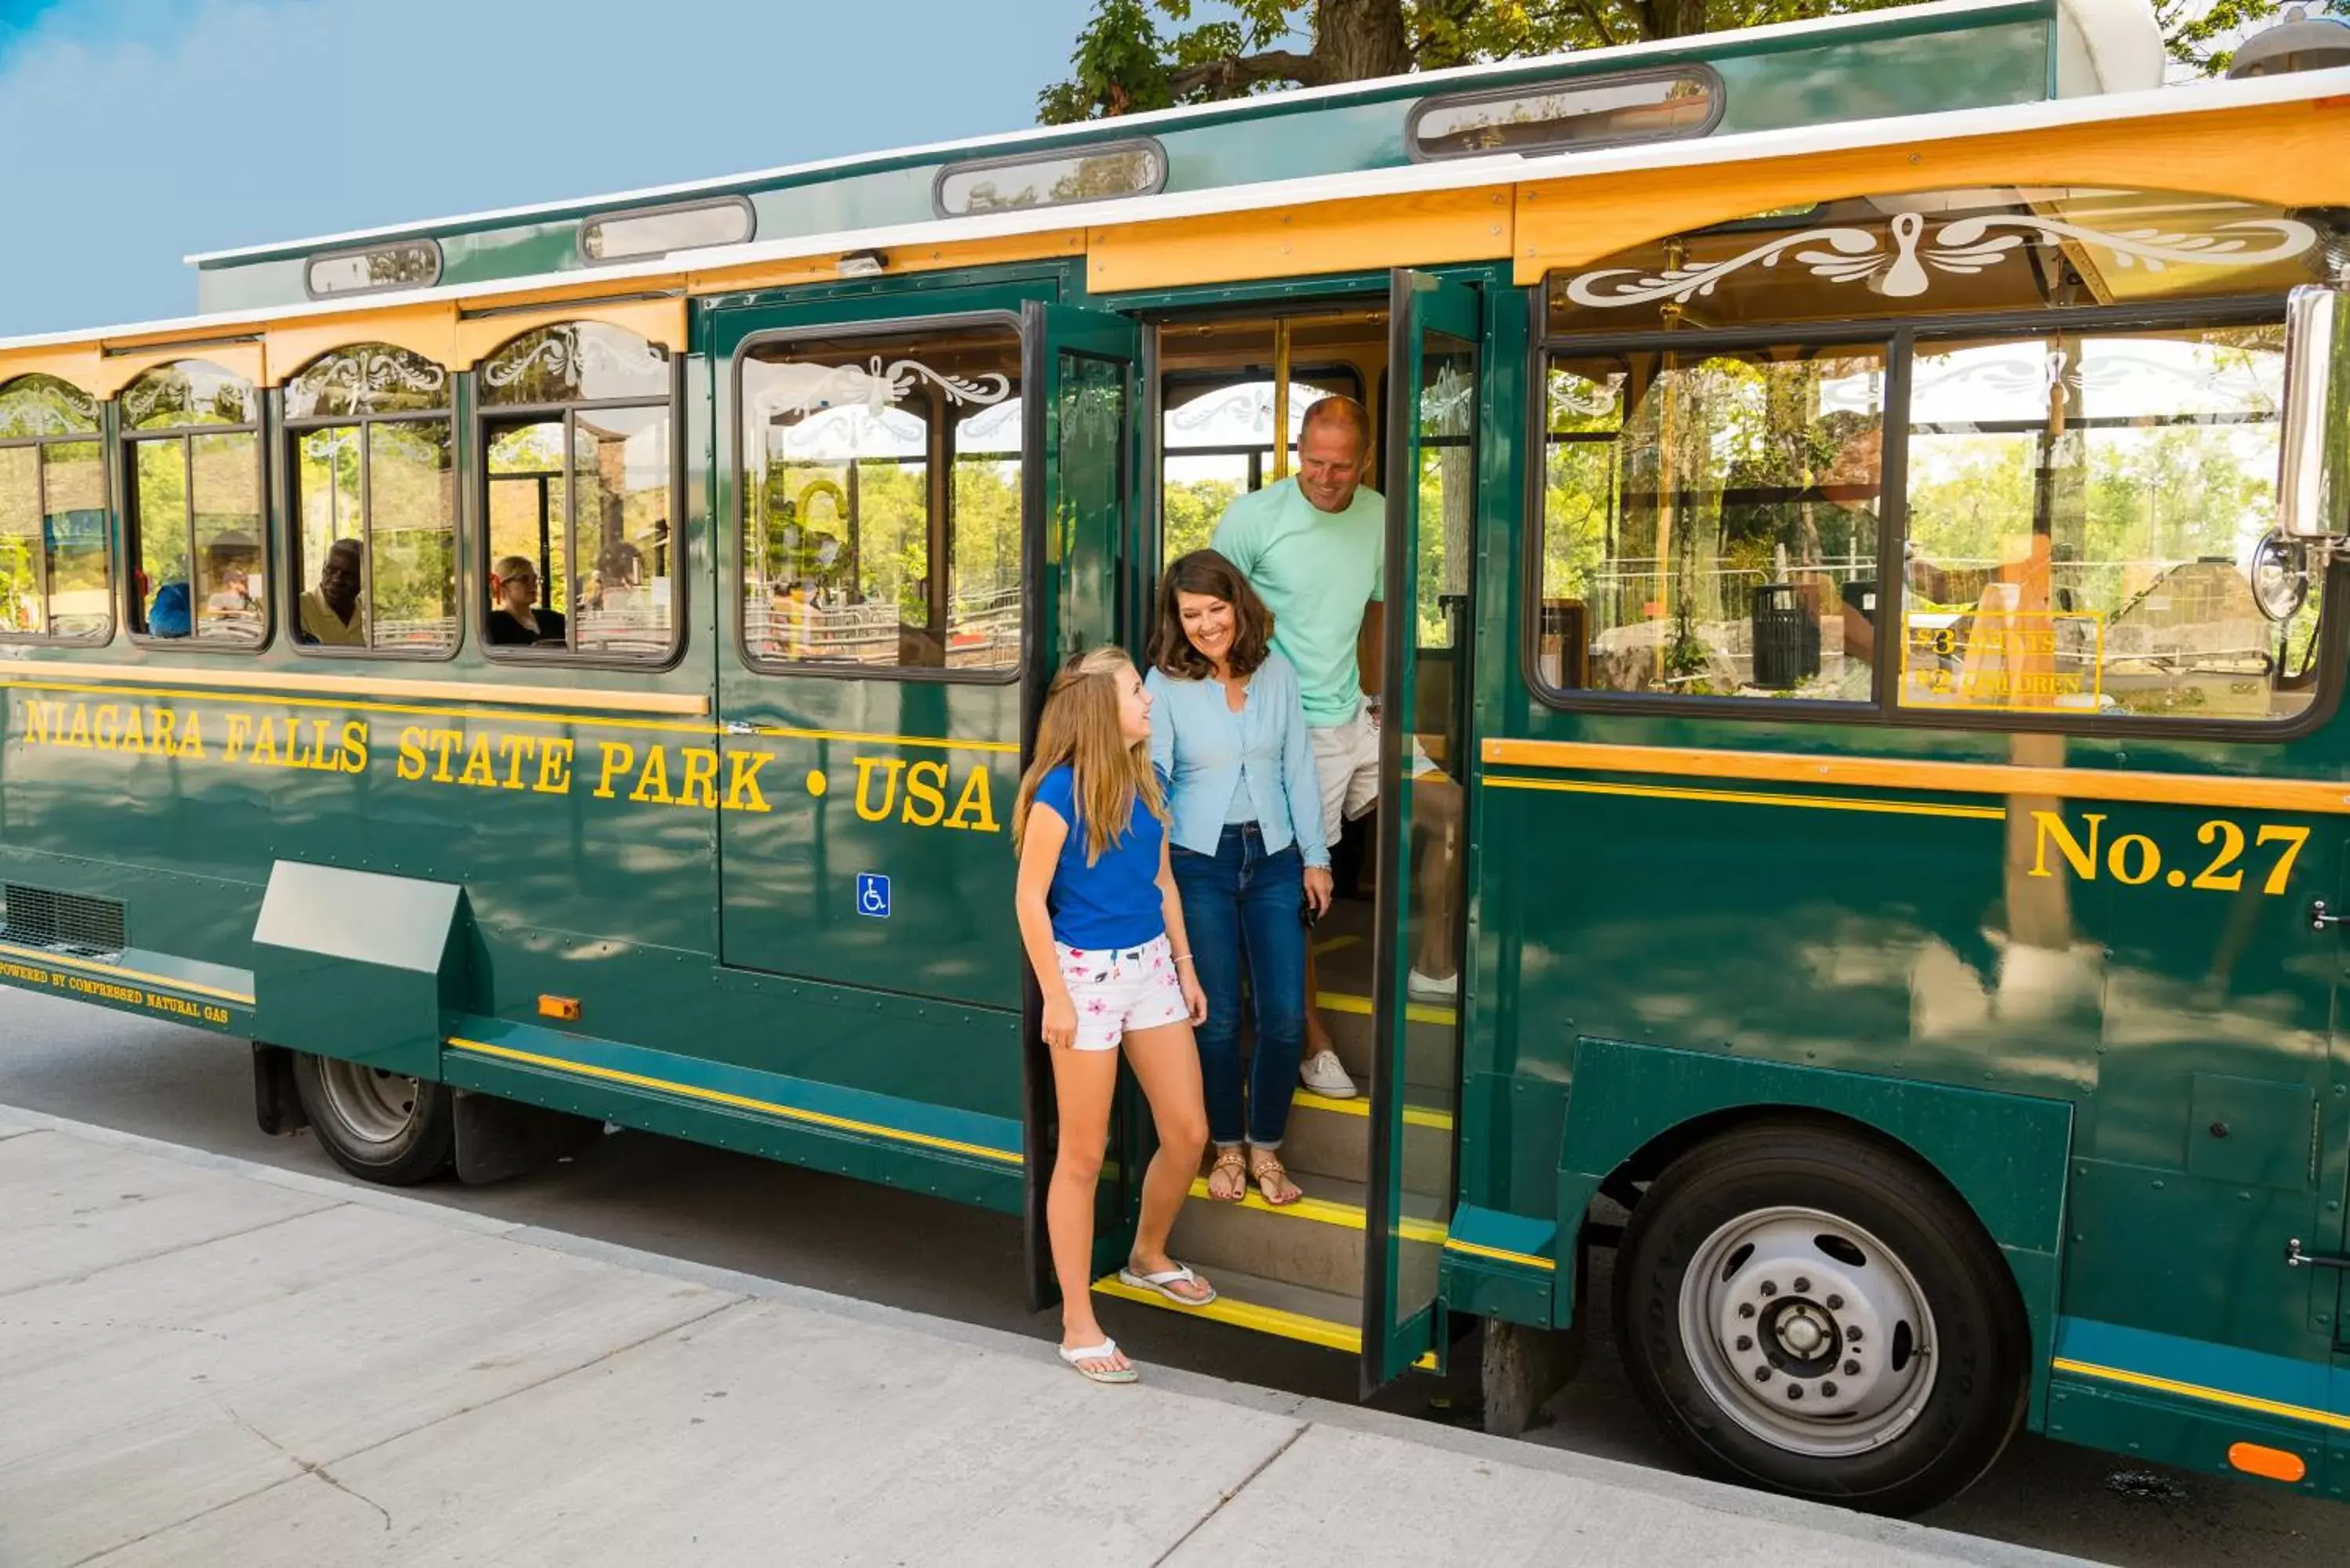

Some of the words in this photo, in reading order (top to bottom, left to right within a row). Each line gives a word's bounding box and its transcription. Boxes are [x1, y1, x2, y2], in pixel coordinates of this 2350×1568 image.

[1962, 673, 2082, 695] CILDREN
[24, 699, 205, 758] NIAGARA
[223, 714, 368, 774] FALLS
[397, 726, 574, 794] STATE
[594, 741, 776, 812] PARK
[851, 756, 1001, 833] USA
[2027, 810, 2312, 895] No.27
[0, 962, 48, 983] POWERED
[52, 973, 66, 988] BY
[70, 977, 143, 1004] COMPRESSED
[146, 993, 201, 1017] NATURAL
[204, 1006, 228, 1024] GAS
